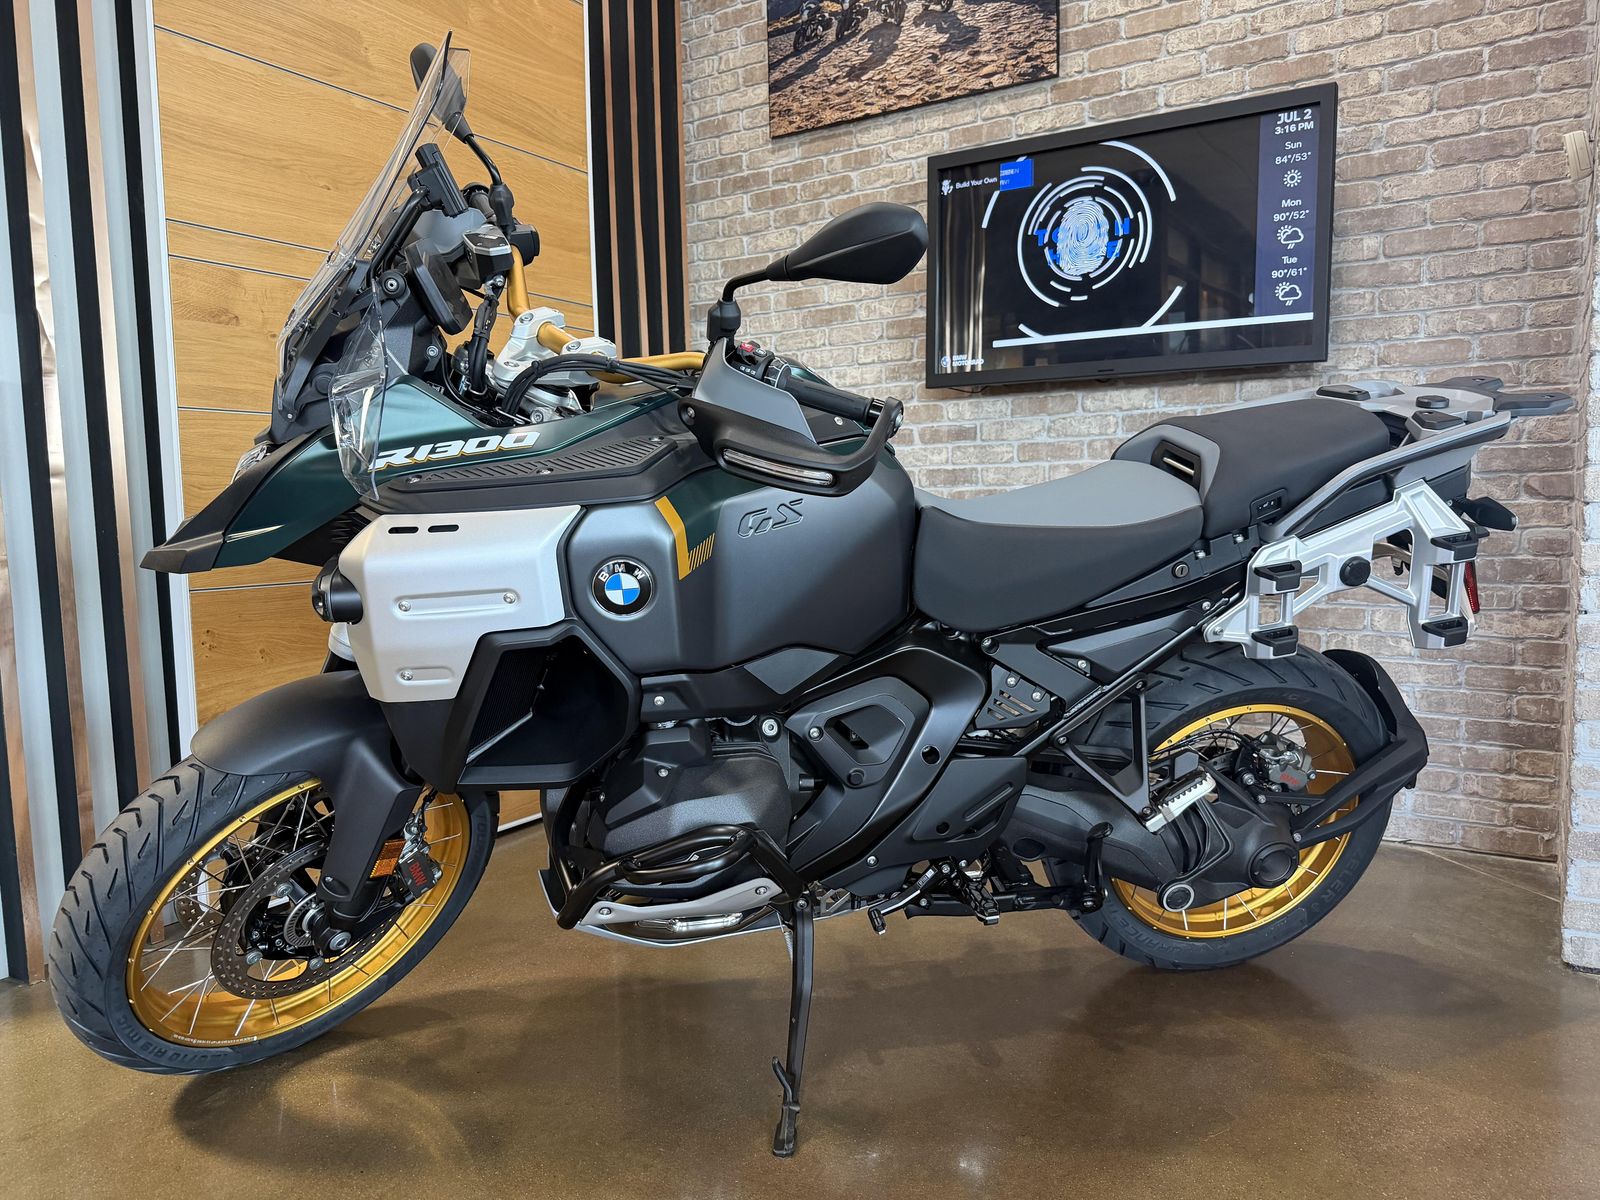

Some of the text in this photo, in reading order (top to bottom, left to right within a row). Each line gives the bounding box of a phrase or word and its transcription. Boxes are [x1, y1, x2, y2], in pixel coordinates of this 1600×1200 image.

[1277, 109, 1312, 125] JUL 2
[1274, 121, 1314, 135] 3:16 PM
[1285, 141, 1302, 150] Sun
[955, 180, 970, 189] Build
[970, 179, 983, 187] Your
[984, 177, 998, 185] Own
[1281, 199, 1302, 208] Mon
[1281, 256, 1298, 265] Tue
[737, 498, 804, 538] GS
[597, 562, 647, 583] BMW
[408, 861, 428, 887] BMW
